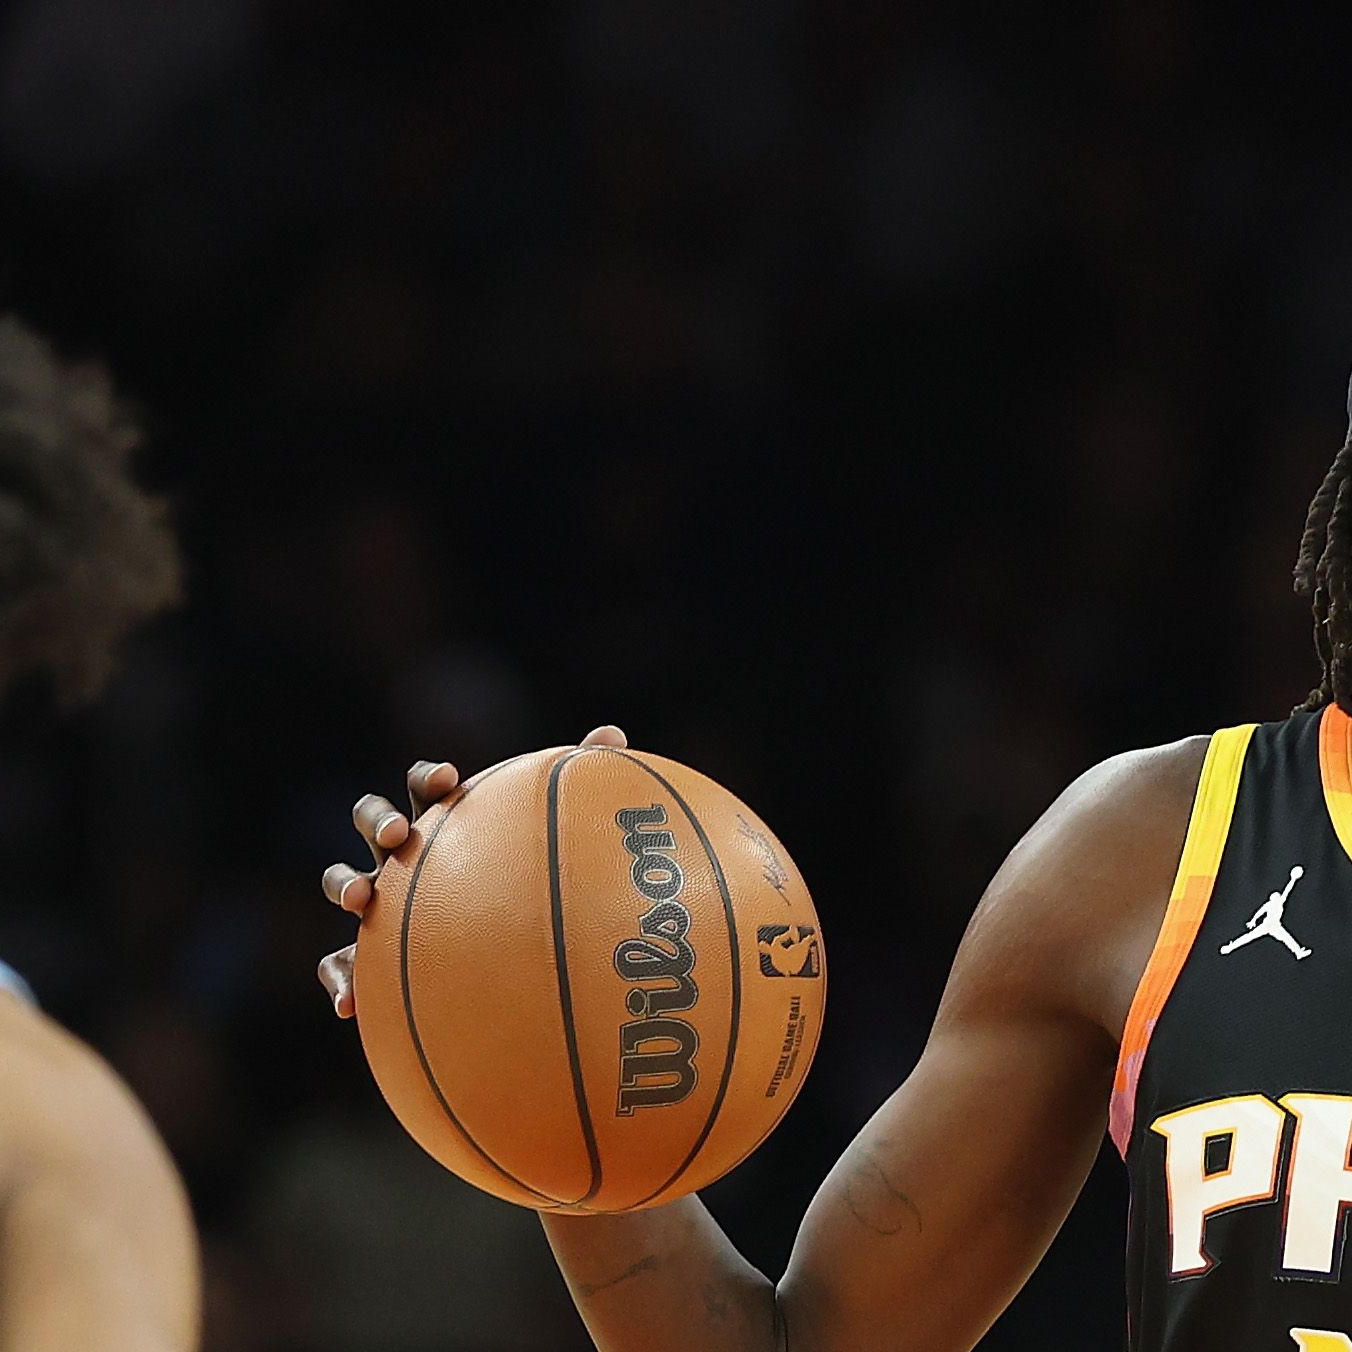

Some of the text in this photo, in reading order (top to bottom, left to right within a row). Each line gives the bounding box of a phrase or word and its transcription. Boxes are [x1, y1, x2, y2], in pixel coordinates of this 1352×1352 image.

[613, 803, 701, 1117] Wilson
[789, 996, 801, 1021] BALL
[782, 1022, 797, 1052] GAME
